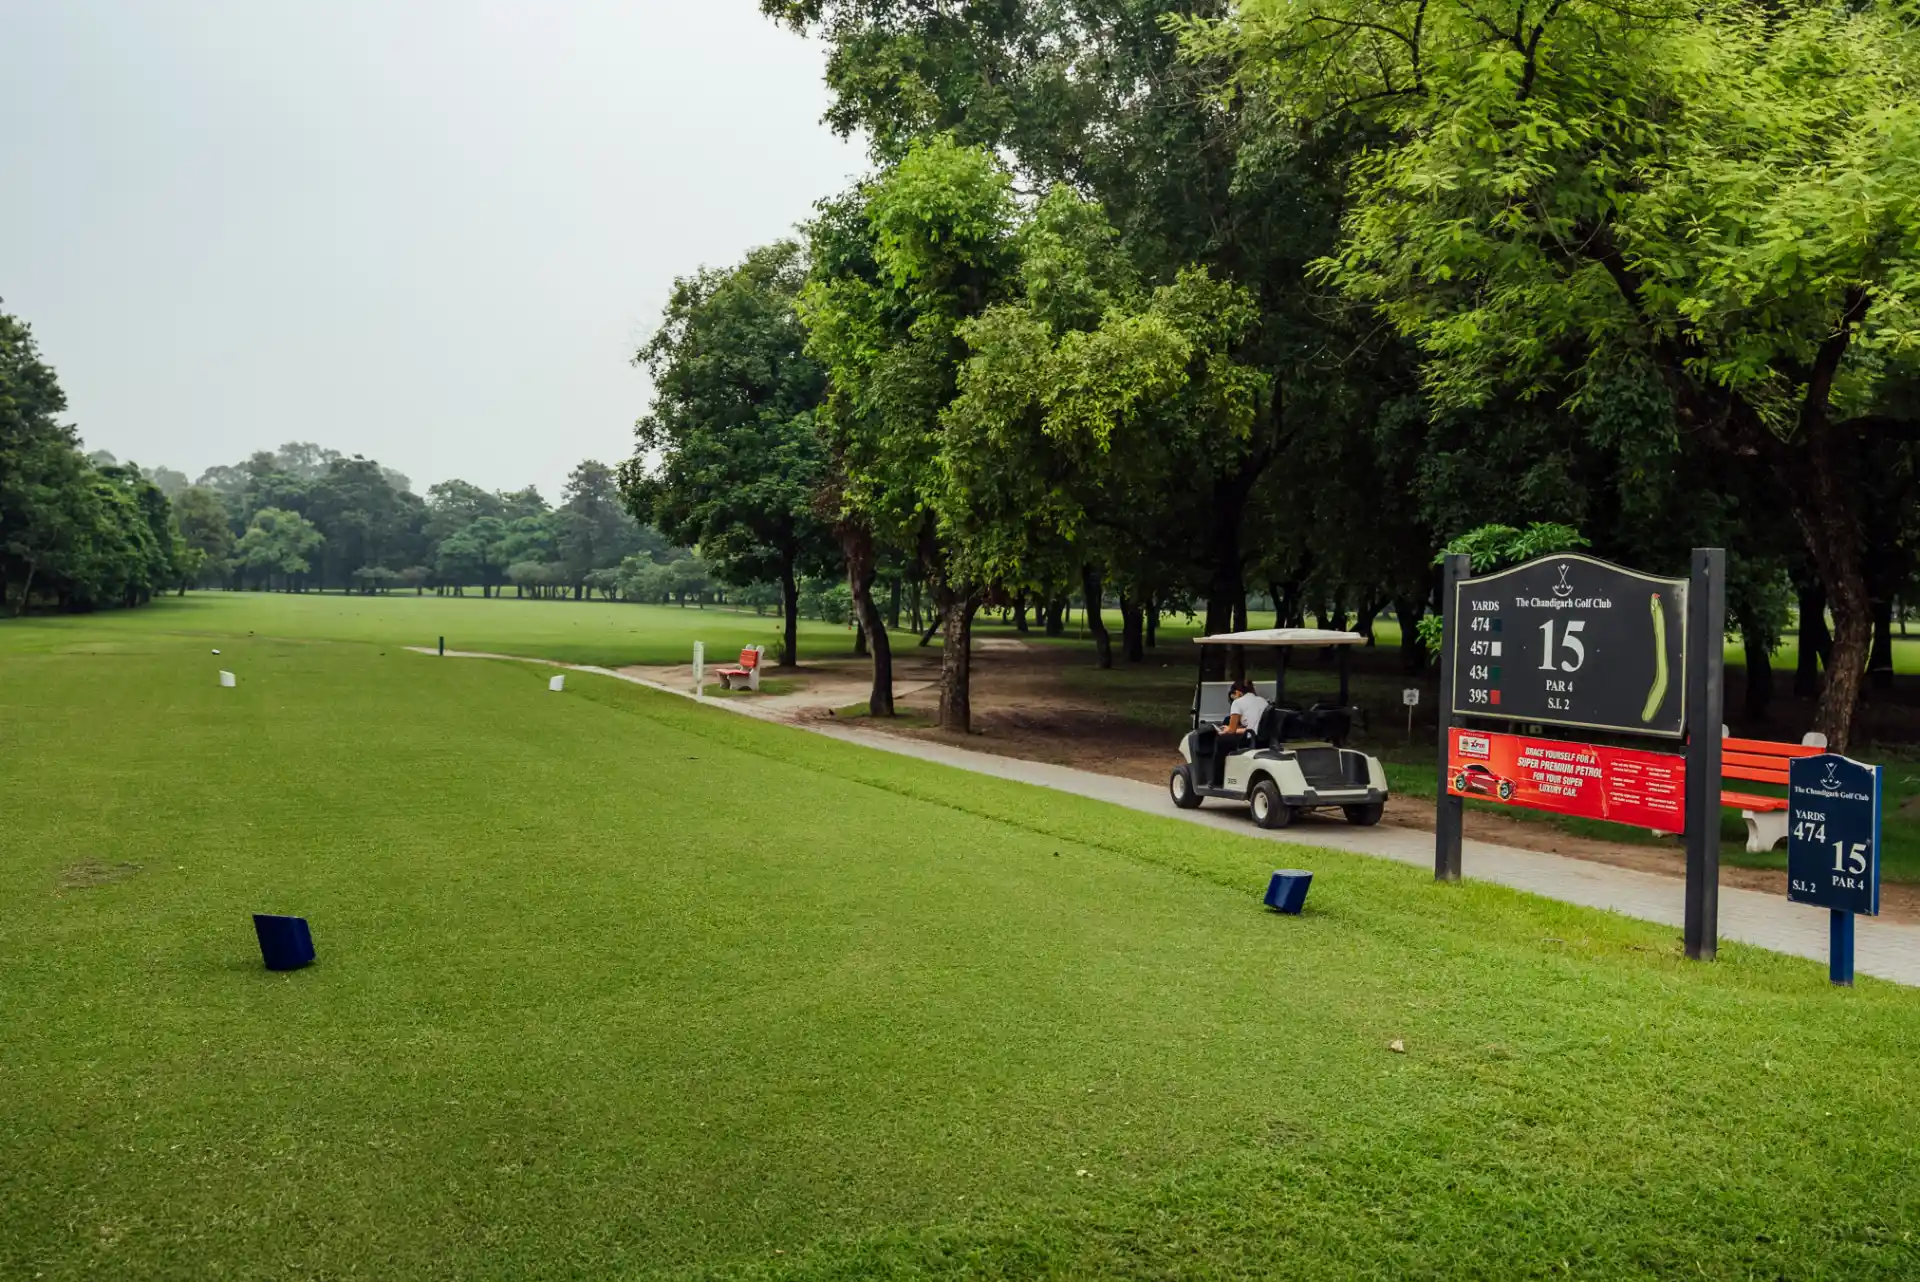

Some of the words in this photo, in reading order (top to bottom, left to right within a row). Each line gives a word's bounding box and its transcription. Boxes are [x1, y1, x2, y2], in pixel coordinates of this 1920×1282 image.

[1471, 600, 1500, 611] YARDS
[1515, 597, 1529, 607] The
[1530, 597, 1573, 610] Chandigarh
[1574, 598, 1591, 609] Golf
[1593, 598, 1612, 609] Club
[1470, 617, 1490, 632] 474
[1470, 641, 1489, 656] 457
[1537, 619, 1586, 673] 15
[1469, 665, 1488, 680] 434
[1545, 679, 1566, 692] PAR
[1567, 680, 1573, 692] 4
[1468, 689, 1488, 704] 395
[1547, 697, 1562, 709] S.I.
[1564, 699, 1570, 710] 2
[1525, 747, 1545, 757] BRACE
[1545, 749, 1576, 761] YOURSELF
[1576, 754, 1589, 764] FOR
[1589, 756, 1595, 765] A
[1517, 756, 1539, 769] SUPER
[1540, 760, 1574, 774] PREMIUM
[1575, 765, 1603, 778] PETROL
[1532, 771, 1544, 781] FOR
[1545, 772, 1561, 783] YOUR
[1562, 776, 1583, 787] SUPER
[1538, 783, 1562, 794] LUXURY
[1794, 786, 1804, 794] The
[1805, 787, 1839, 798] Chandigarh
[1839, 790, 1854, 800] Golf
[1854, 792, 1870, 802] Club
[1795, 809, 1826, 822] YARDS
[1793, 821, 1826, 844] 474
[1831, 840, 1867, 875] 15
[1792, 879, 1808, 892] S.I.
[1810, 882, 1816, 893] 2
[1831, 875, 1855, 890] PAR
[1857, 880, 1864, 890] 4
